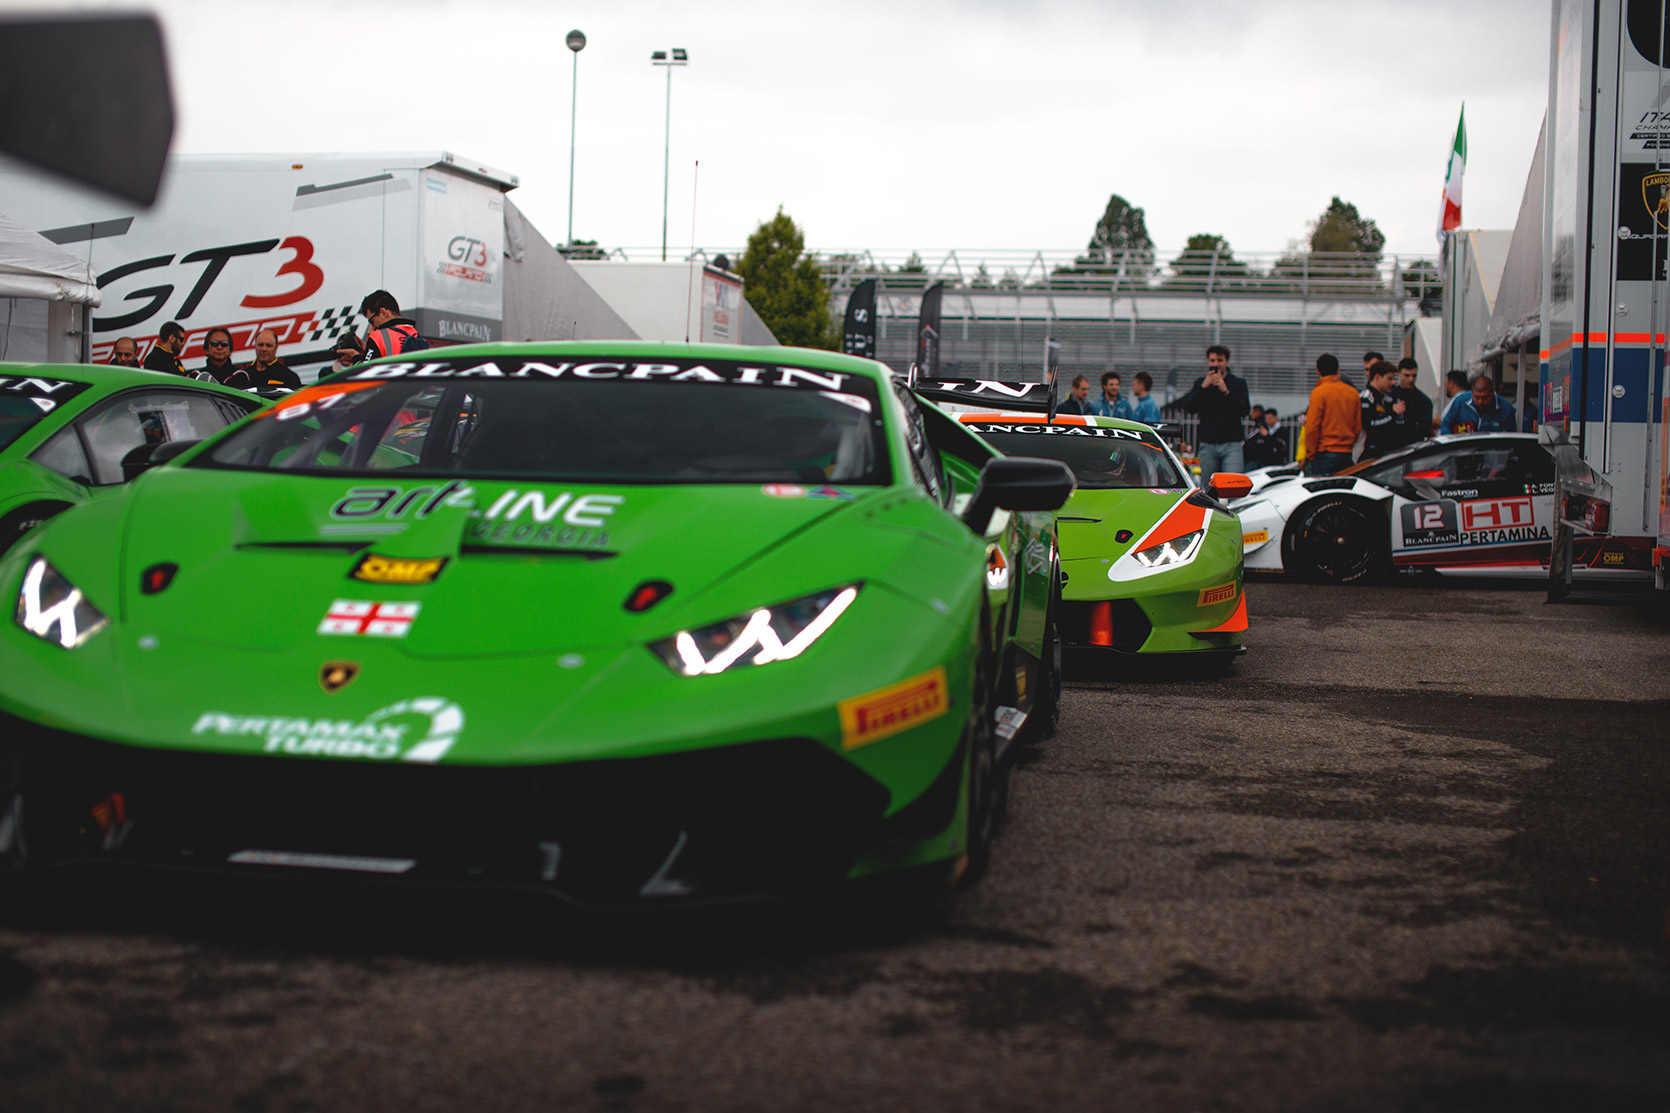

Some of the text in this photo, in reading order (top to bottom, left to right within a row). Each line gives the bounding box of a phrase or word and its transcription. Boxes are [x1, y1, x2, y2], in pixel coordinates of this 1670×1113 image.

[1646, 176, 1670, 188] LAMBO
[447, 235, 487, 267] GT3
[92, 236, 324, 331] GT3
[438, 319, 493, 342] BLANCPAIN
[345, 361, 850, 391] BLANCPAIN
[966, 424, 1143, 440] ANCPAIN
[1413, 504, 1446, 530] 12
[1465, 500, 1529, 528] HT
[471, 521, 611, 550] GEORGIA
[1405, 533, 1458, 546] BLANCPAIN
[1459, 525, 1551, 545] PERTAMINA
[1603, 553, 1625, 563] OMP
[1203, 583, 1236, 604] PIRELLI
[262, 734, 402, 760] TURBO
